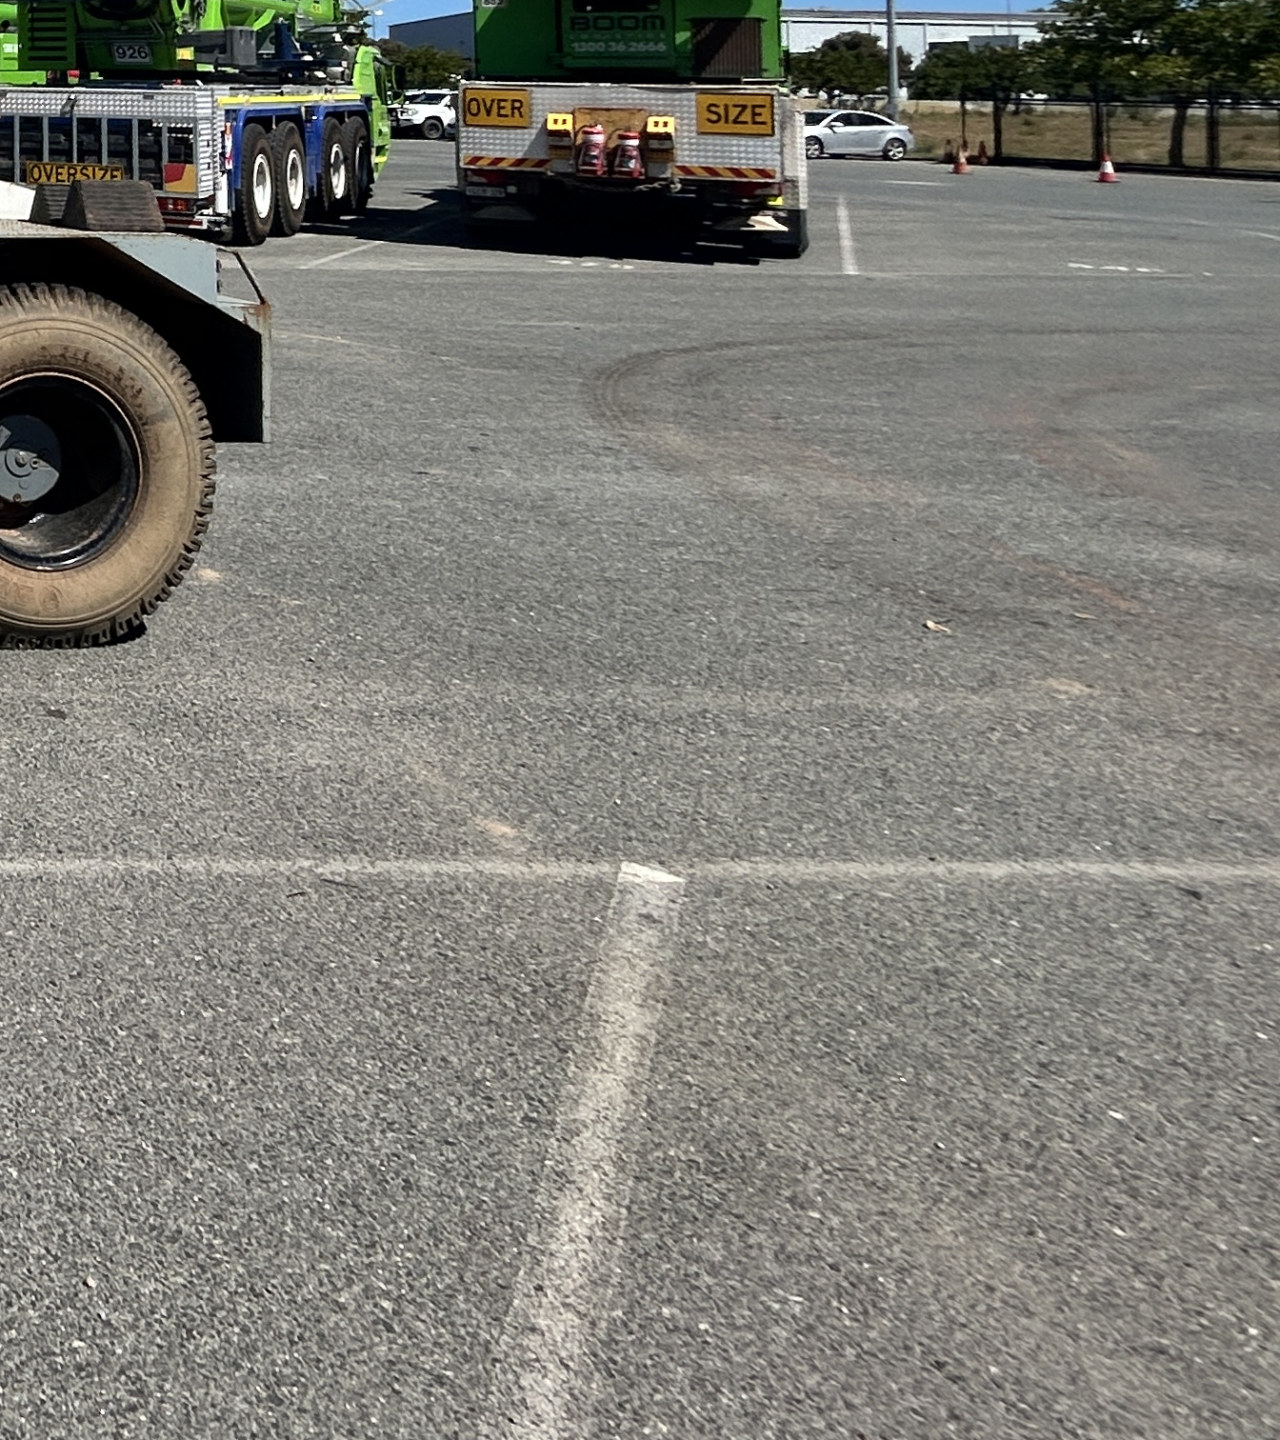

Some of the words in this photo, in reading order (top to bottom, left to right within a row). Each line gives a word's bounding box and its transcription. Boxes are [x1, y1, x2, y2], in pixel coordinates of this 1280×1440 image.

[570, 16, 665, 31] BOOM
[116, 45, 148, 60] 926
[466, 97, 524, 119] OVER
[705, 103, 768, 126] SIZE
[31, 164, 121, 183] OVERSIZE
